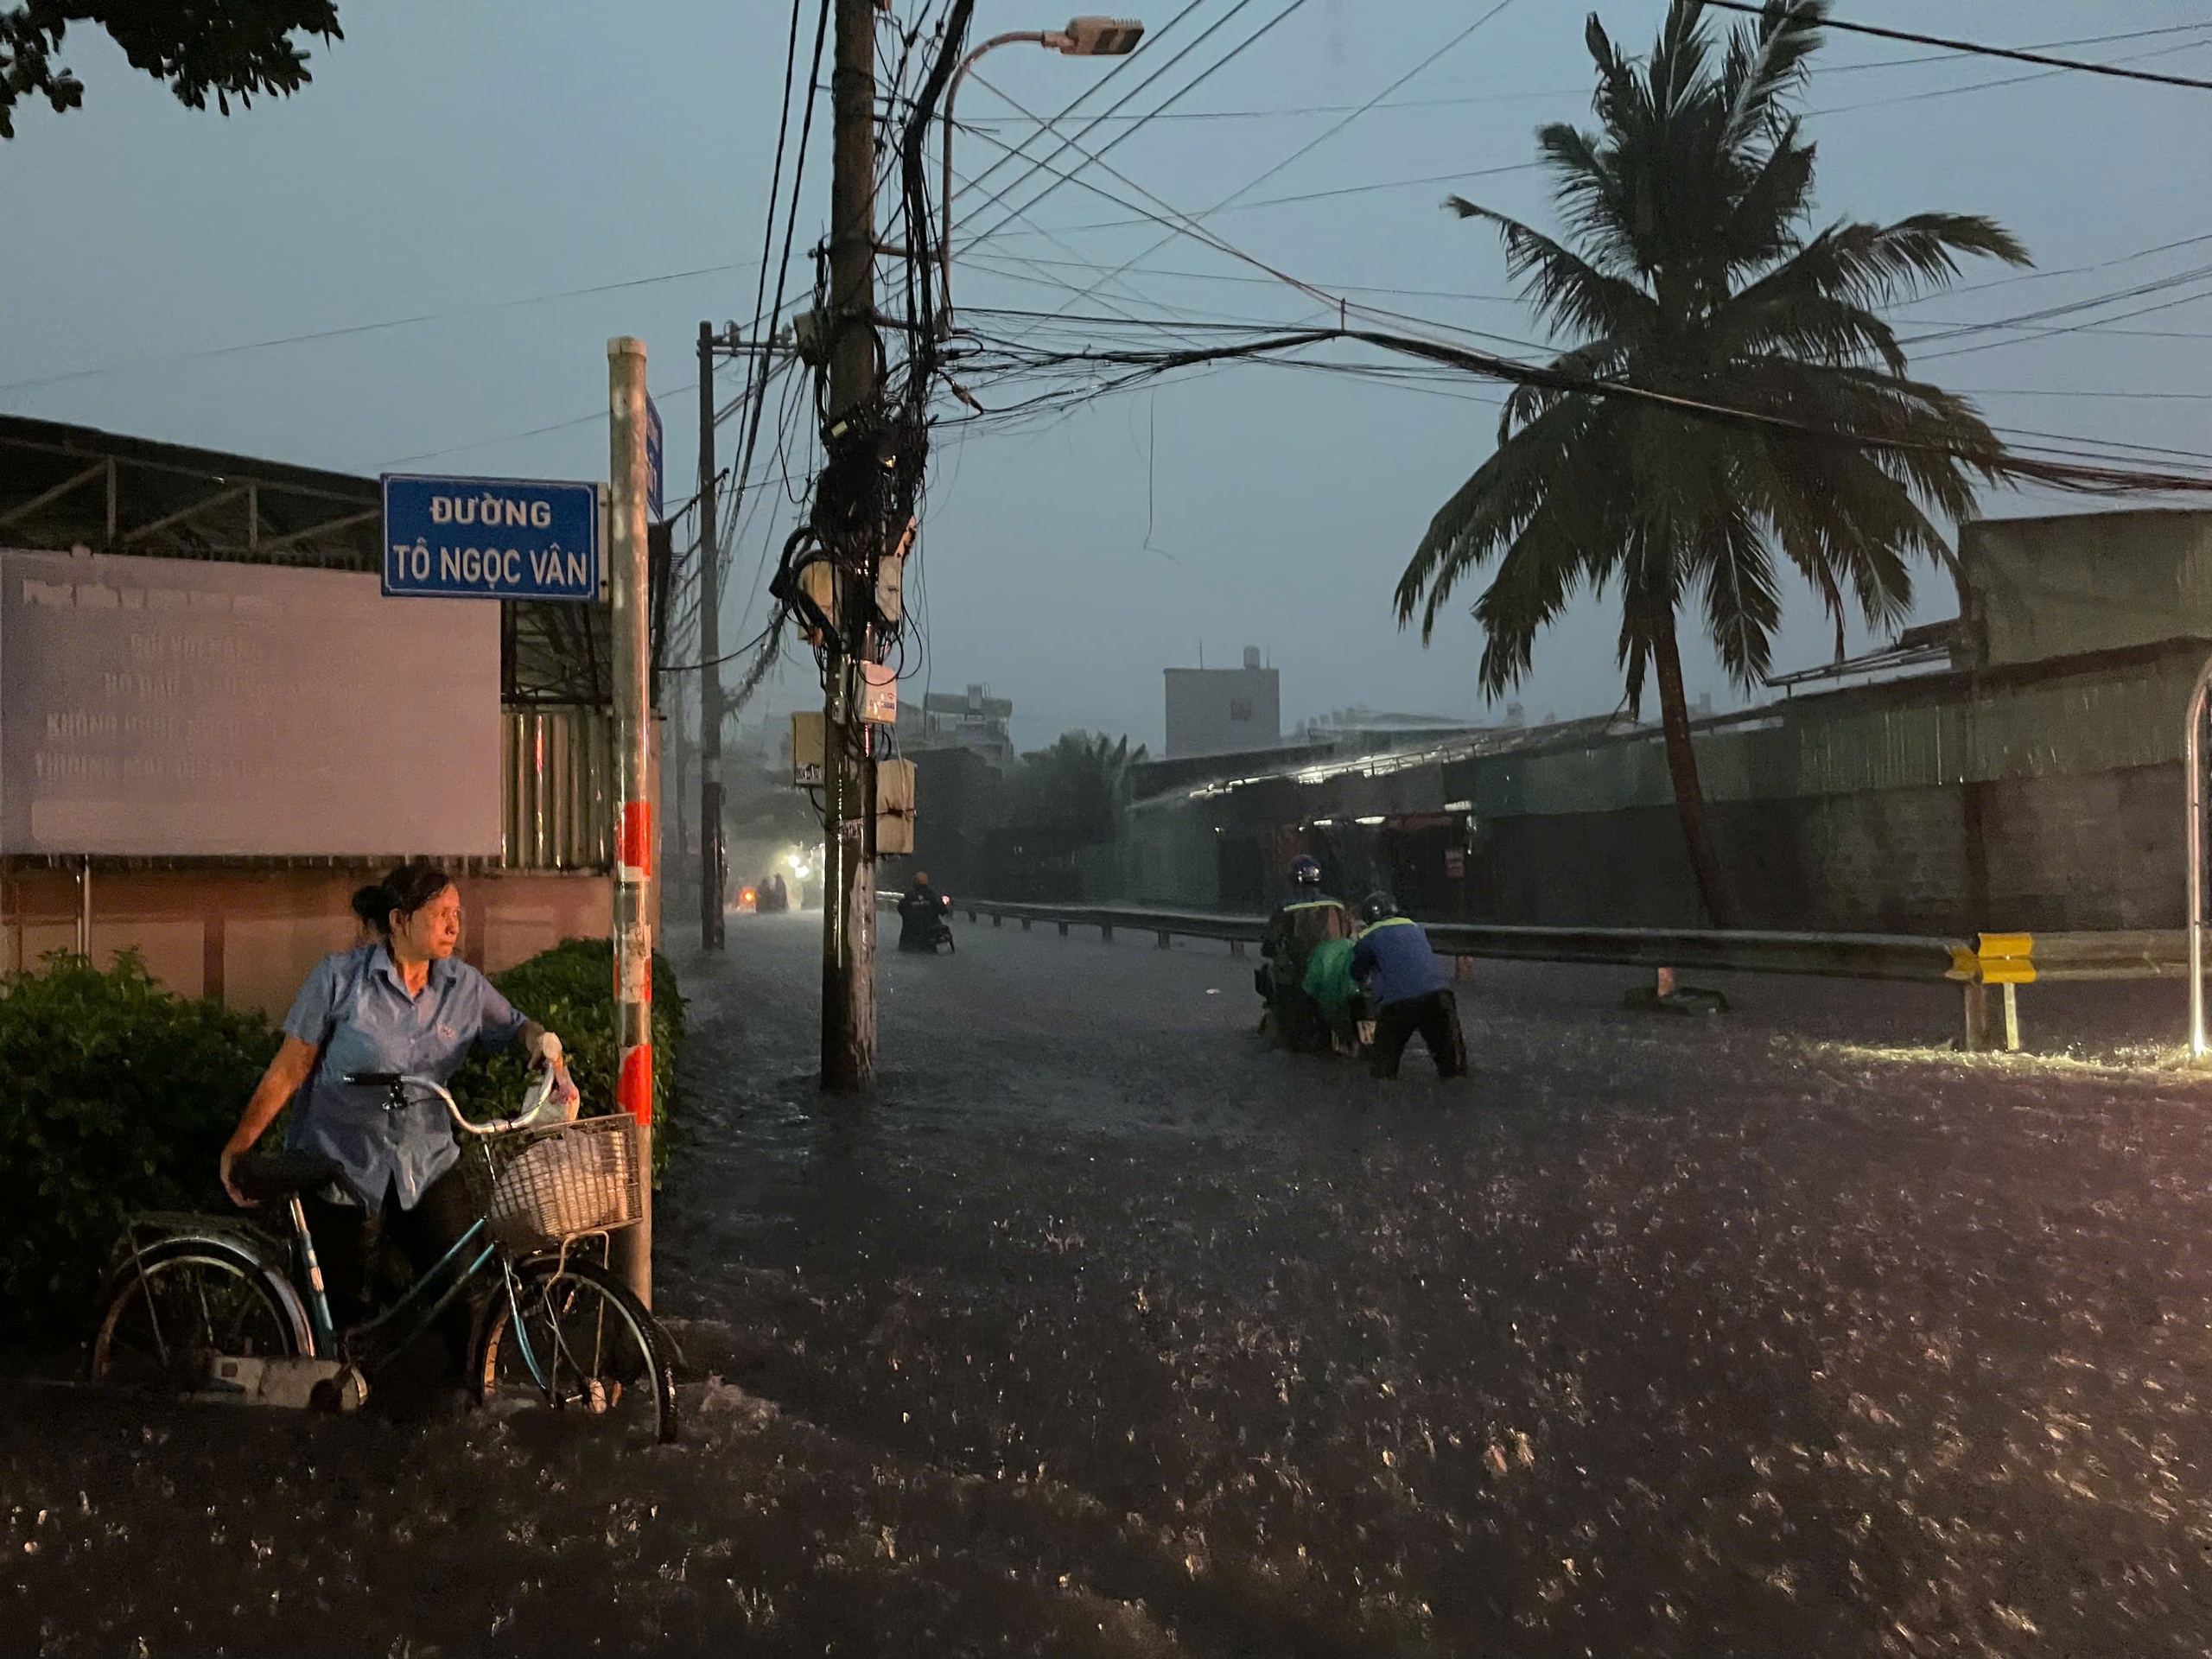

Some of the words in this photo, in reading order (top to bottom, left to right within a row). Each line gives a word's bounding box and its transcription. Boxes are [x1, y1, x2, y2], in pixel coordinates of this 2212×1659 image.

[429, 493, 551, 528] ĐƯỜNG
[392, 537, 430, 581] TÔ
[440, 546, 521, 589] NGỌC
[530, 542, 587, 587] VÂN
